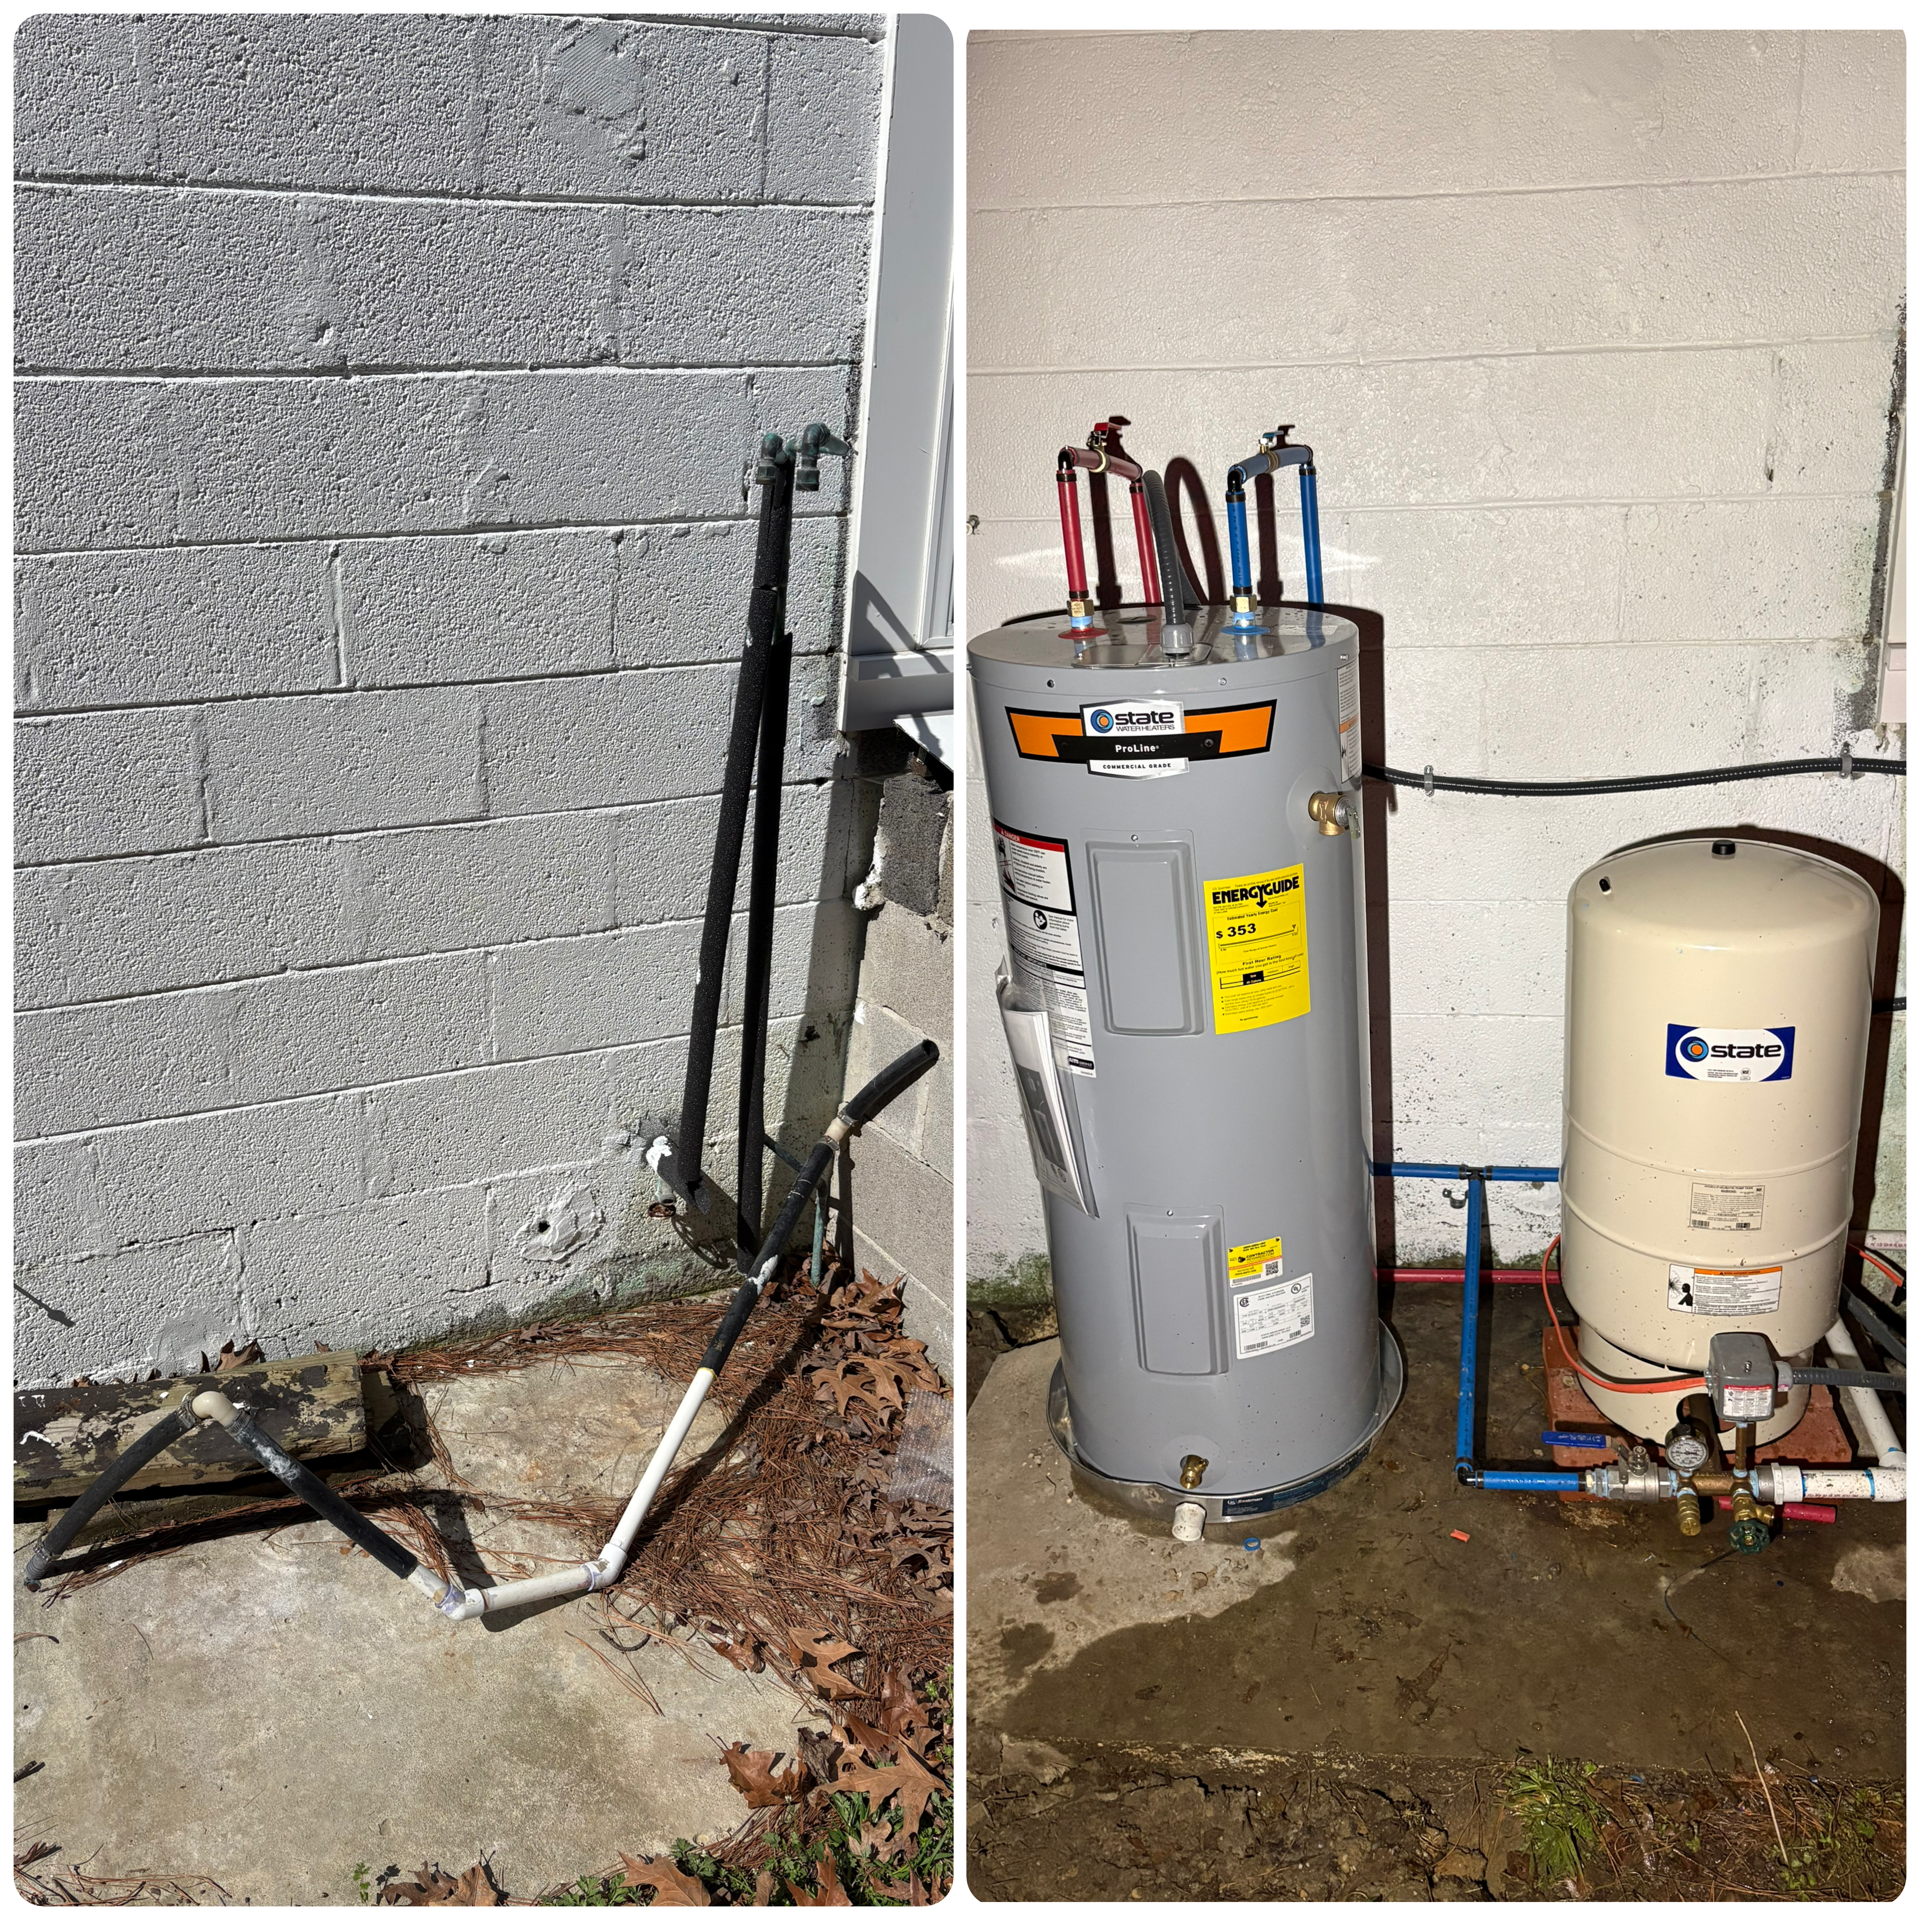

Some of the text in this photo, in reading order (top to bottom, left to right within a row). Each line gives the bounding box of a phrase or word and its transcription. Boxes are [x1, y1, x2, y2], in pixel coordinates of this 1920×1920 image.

[1115, 711, 1175, 726] state
[1142, 724, 1175, 732] HEATERS
[1212, 876, 1300, 905] ENERGYGUIDE
[1216, 923, 1257, 939] $ 353
[1710, 1043, 1782, 1058] state
